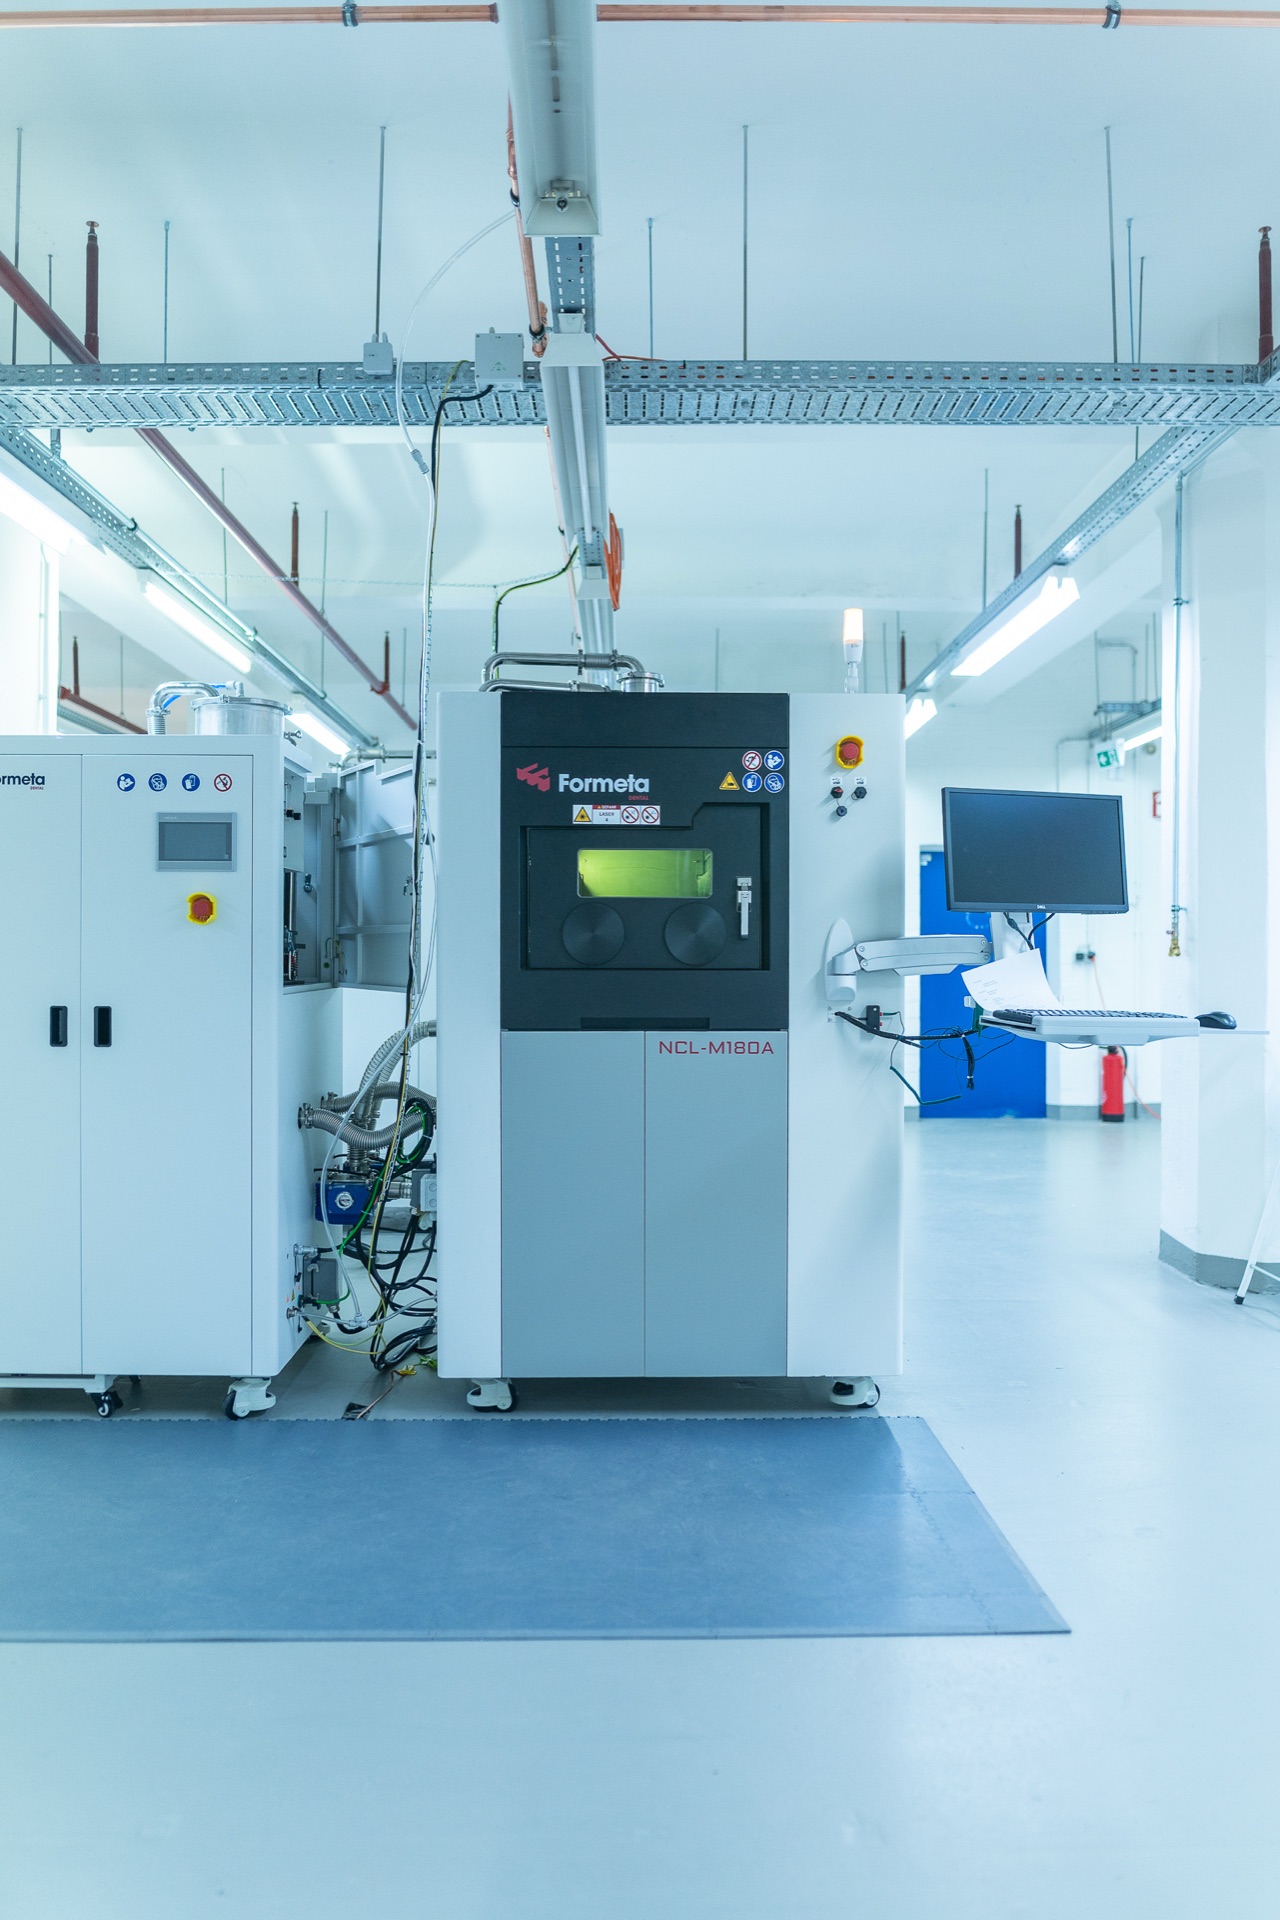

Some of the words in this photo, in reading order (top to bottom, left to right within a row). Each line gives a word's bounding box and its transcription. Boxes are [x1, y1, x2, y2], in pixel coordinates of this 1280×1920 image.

[0, 773, 45, 785] rmeta
[558, 773, 650, 793] Formeta
[659, 1040, 775, 1055] NCL-M180A
